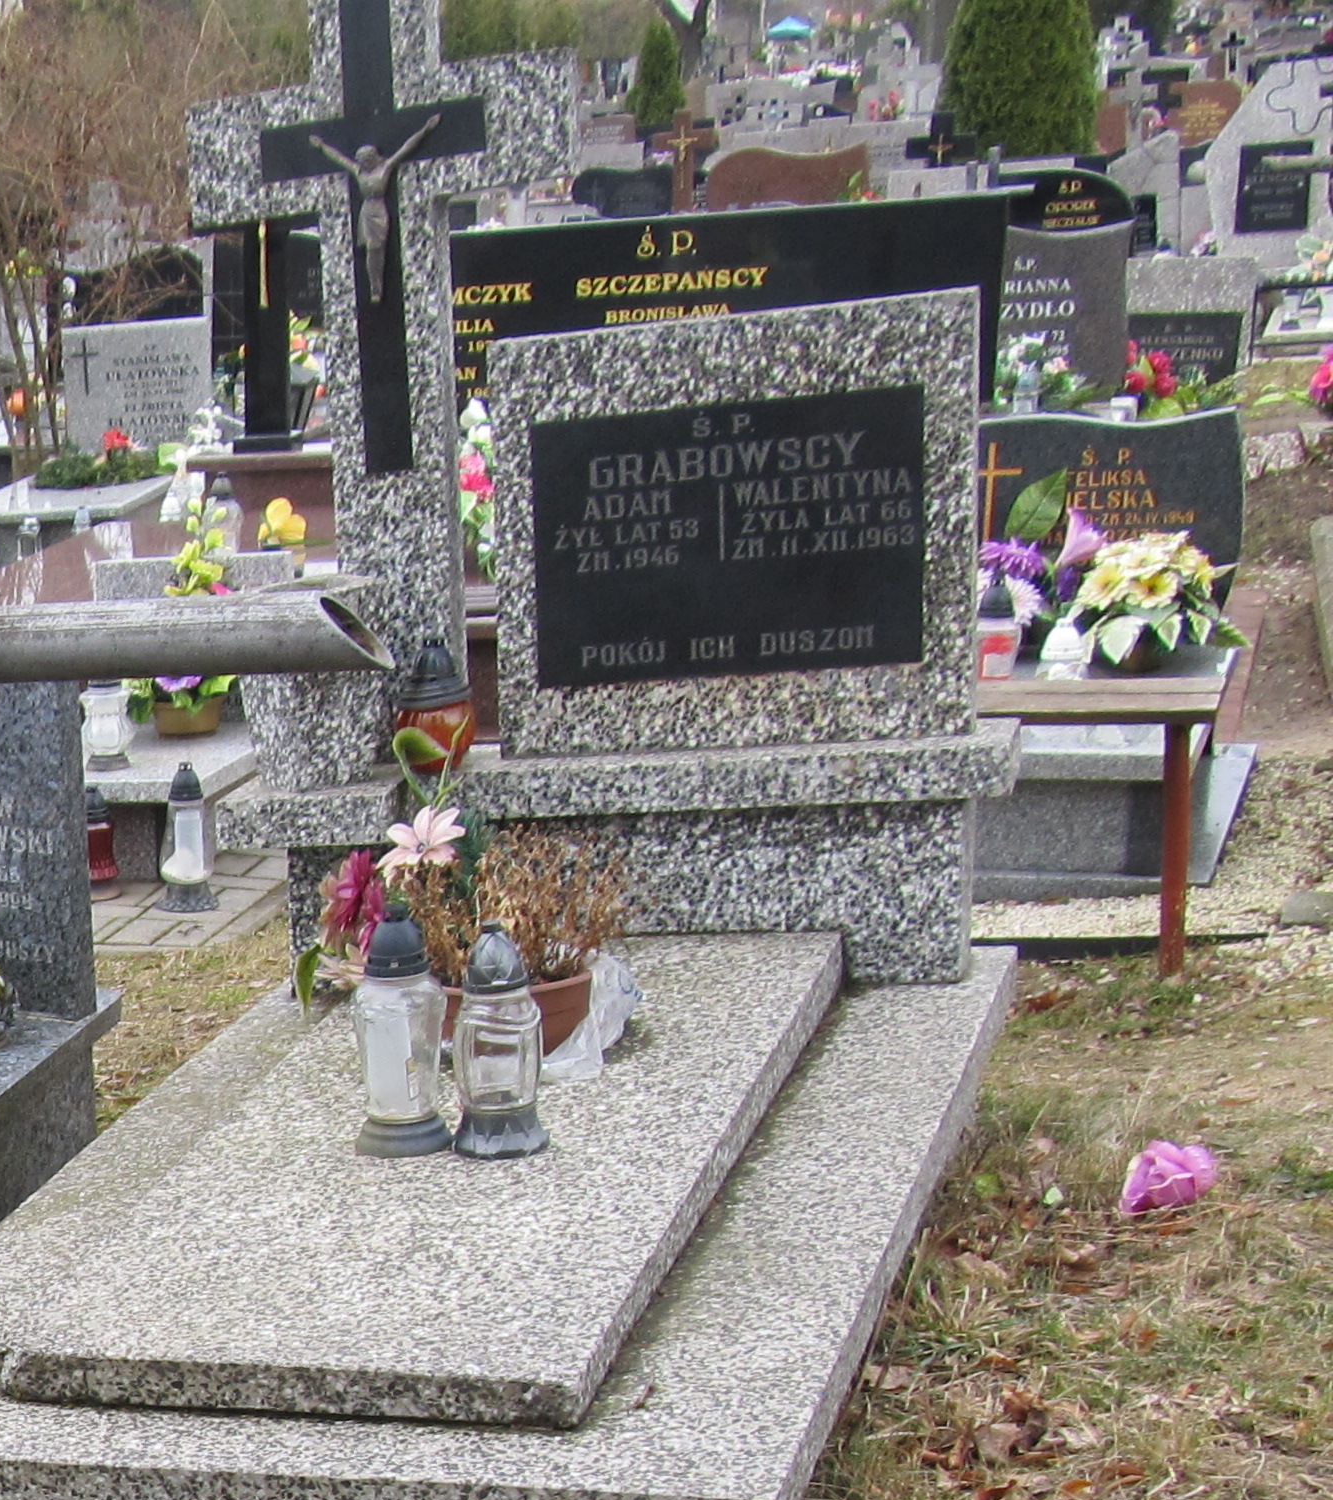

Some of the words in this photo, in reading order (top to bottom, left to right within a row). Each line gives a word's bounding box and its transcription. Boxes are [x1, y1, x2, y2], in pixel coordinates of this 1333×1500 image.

[576, 266, 769, 298] SZCZEPAŃSCY
[604, 303, 731, 325] BRONISŁAWA
[589, 431, 866, 490] GRABOWSCY
[733, 467, 914, 507] WALENTYNA
[583, 489, 674, 521] ADAM
[823, 504, 870, 526] LAT
[881, 499, 912, 521] 66
[554, 525, 604, 550] ŻYŁ
[615, 522, 661, 545] LAT
[669, 518, 699, 540] 53
[582, 636, 666, 668] POKÓJ
[690, 634, 736, 660] ICH
[760, 623, 875, 657] DUSZOM
